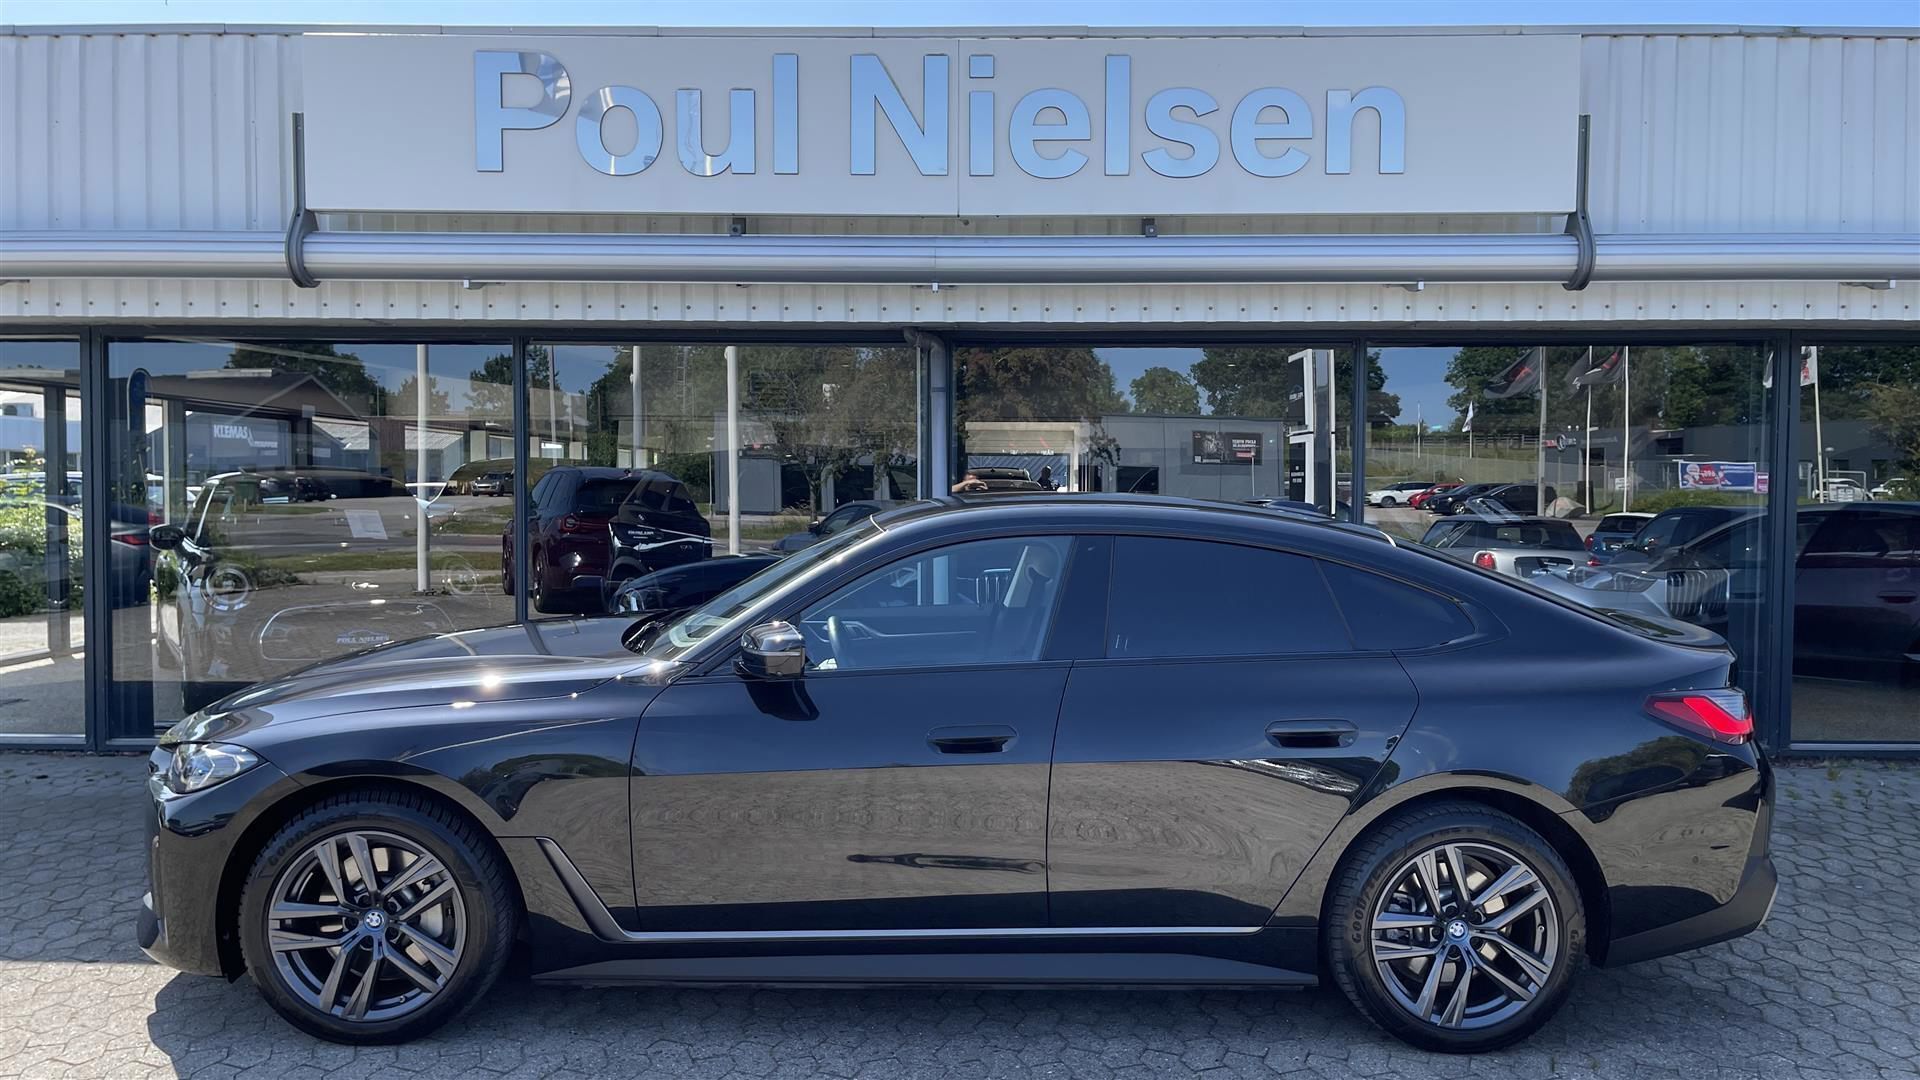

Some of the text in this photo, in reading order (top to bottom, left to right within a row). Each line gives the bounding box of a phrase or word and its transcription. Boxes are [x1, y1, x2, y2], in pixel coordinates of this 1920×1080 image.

[473, 50, 1407, 179] Poul Nielsen
[213, 424, 248, 439] KLEMAS
